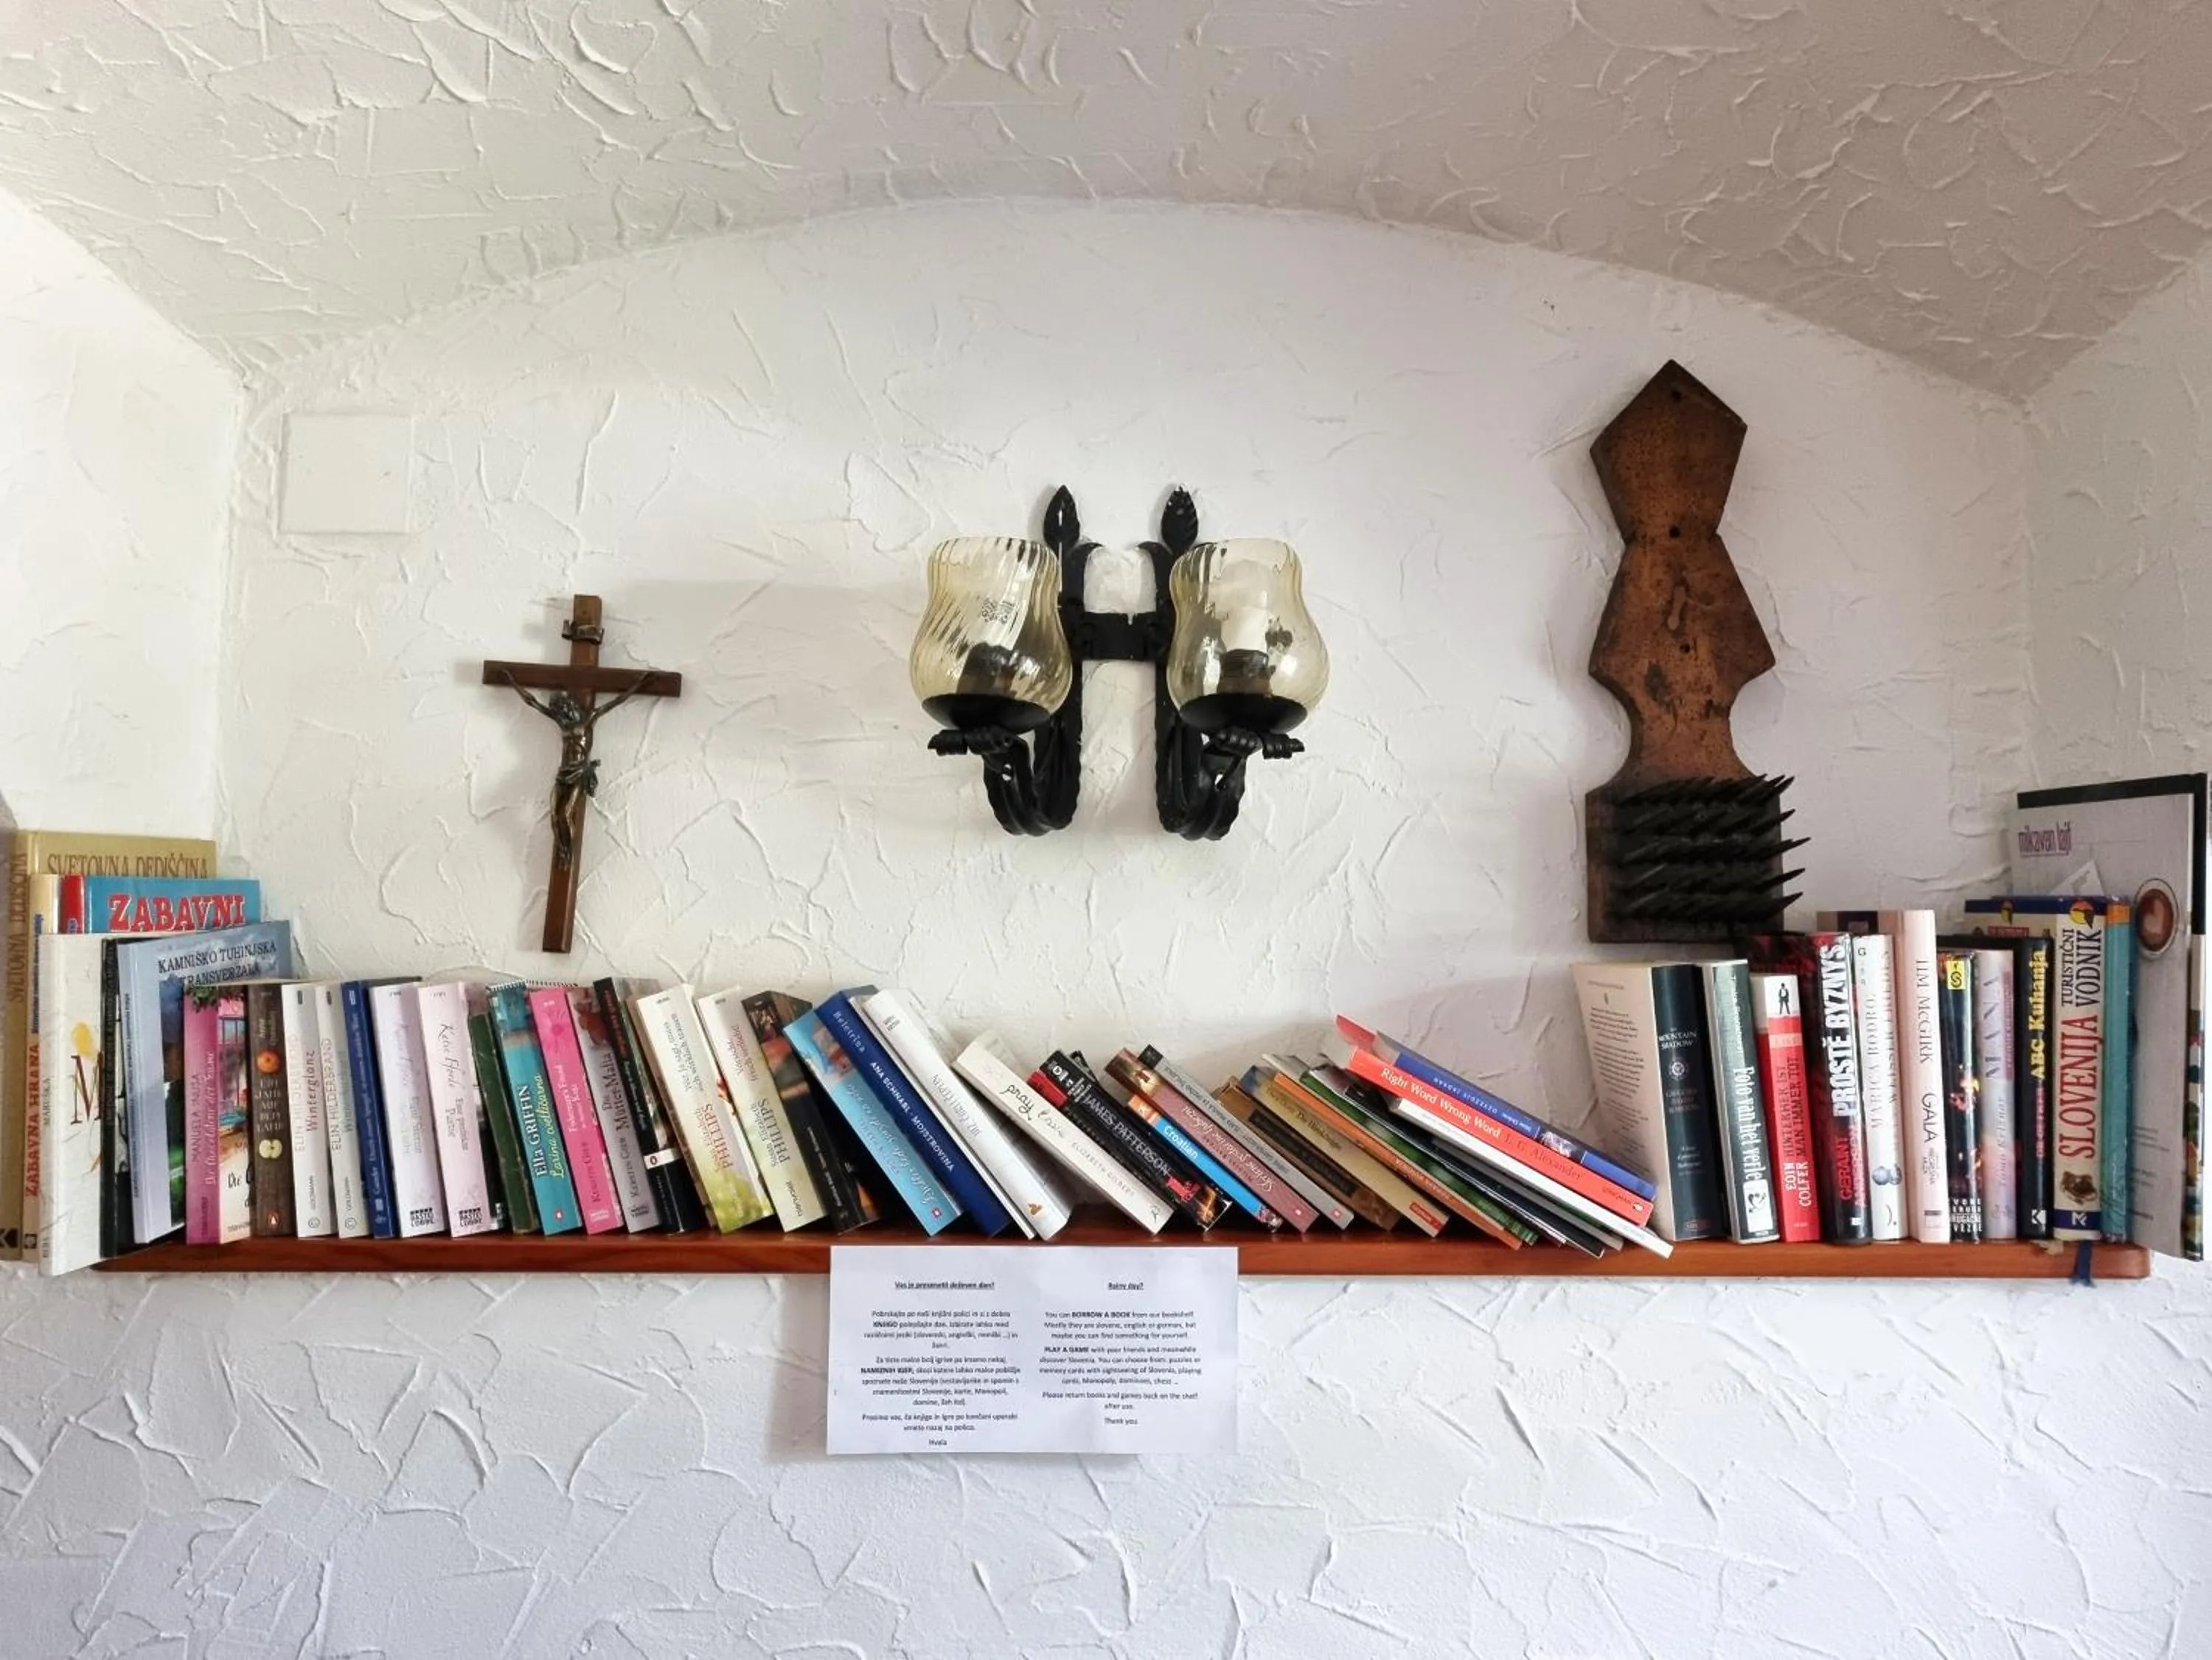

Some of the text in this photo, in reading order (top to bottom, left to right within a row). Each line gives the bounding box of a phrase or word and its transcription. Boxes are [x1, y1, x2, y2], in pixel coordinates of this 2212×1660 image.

[108, 893, 246, 933] ZABAVNI
[158, 949, 218, 974] KAMNIŠKO
[2059, 928, 2074, 1006] TURISTIČNI
[2075, 930, 2102, 1008] VODNIK
[2028, 949, 2048, 1081] ABC Kuhanja
[27, 1043, 40, 1107] HRANA
[305, 1050, 319, 1133] Winterglanz
[321, 1038, 342, 1151] ELIN HILDERBRAND
[998, 1080, 1042, 1122] pray
[1788, 1056, 1806, 1157] MAN IMMER TOT
[1822, 1035, 1857, 1117] PROSTĚ
[2058, 1014, 2104, 1159] SLOVENIJA
[189, 1111, 203, 1162] MANUELA
[518, 1084, 548, 1177] Ella GRIFFIN
[700, 1101, 734, 1170] PHILLIPS
[748, 1103, 781, 1167] Susan Elizabeth
[754, 1096, 792, 1164] PHILLIPS
[869, 1059, 886, 1078] ANA
[880, 1075, 912, 1113] SCHNABL
[909, 1115, 957, 1172] MOJSTROVINA
[1082, 1091, 1118, 1127] JAMES
[1111, 1118, 1172, 1179] PATTERSON
[1161, 1123, 1201, 1161] Croatian
[1378, 1067, 1409, 1090] Right
[1406, 1081, 1438, 1105] Word
[1435, 1097, 1475, 1126] Wrong
[1471, 1115, 1503, 1139] Word
[1528, 1145, 1585, 1183] Alexander
[1732, 1065, 1767, 1182] Foto van het verle
[1779, 1084, 1794, 1157] HINTERHER
[1921, 1093, 1938, 1144] GALA
[24, 1114, 40, 1198] ZABAVNA
[1784, 1162, 1797, 1191] EOIN
[1796, 1161, 1812, 1207] COLFER
[1834, 1135, 1853, 1200] GERAINT
